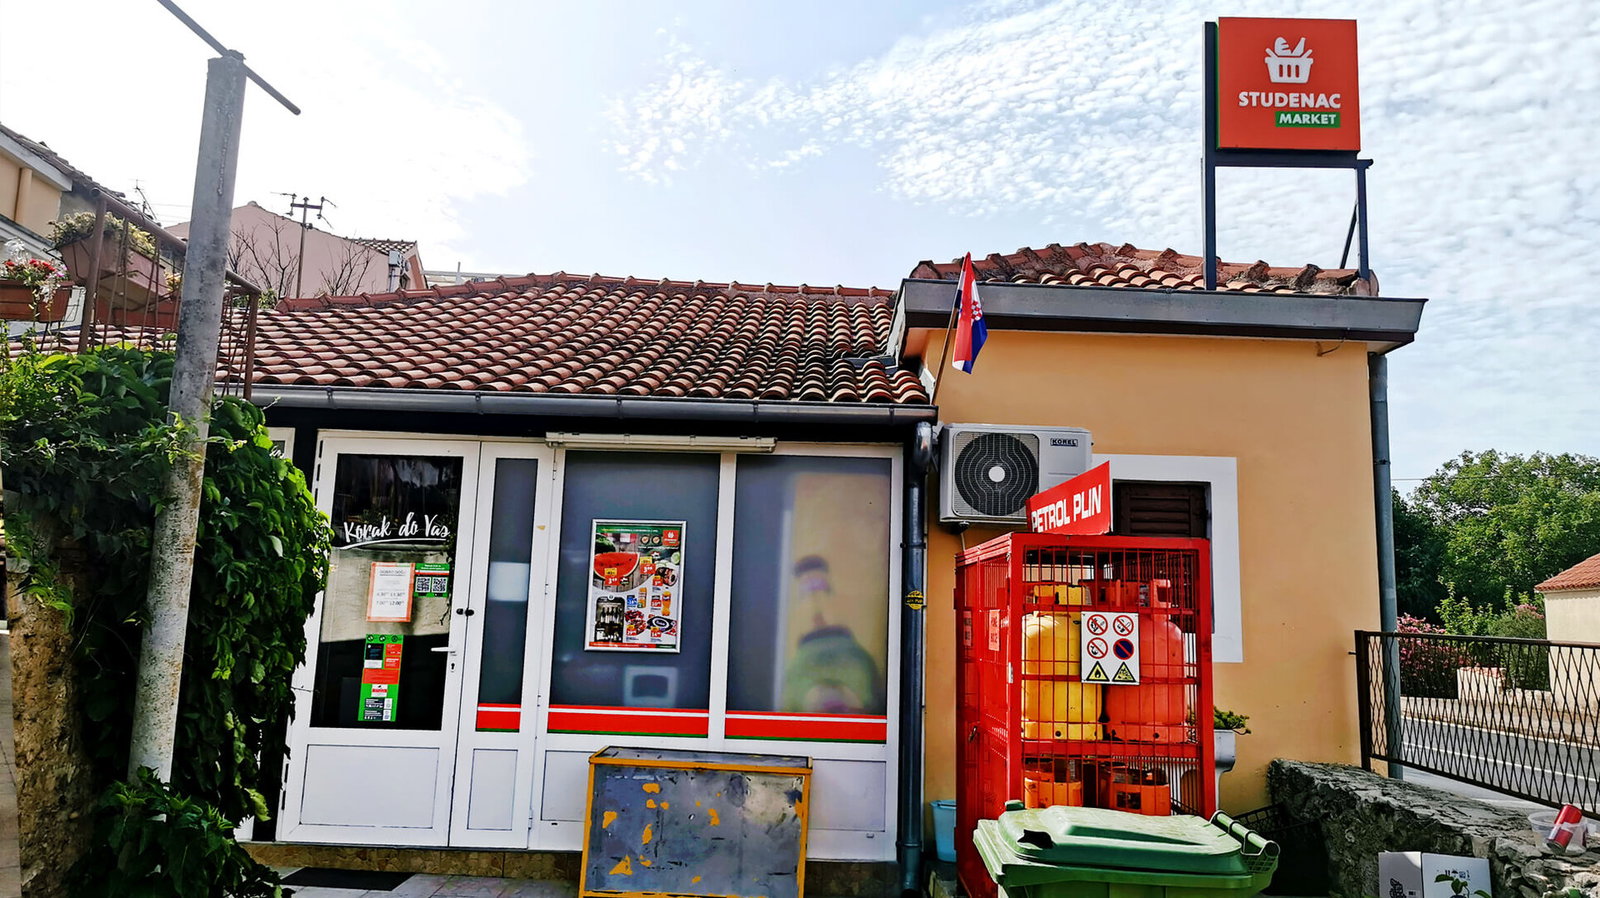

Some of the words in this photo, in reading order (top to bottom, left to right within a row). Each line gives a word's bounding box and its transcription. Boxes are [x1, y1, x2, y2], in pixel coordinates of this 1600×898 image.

[1238, 91, 1341, 109] STUDENAC
[1279, 113, 1336, 125] MARKET
[1052, 438, 1077, 446] KOREL
[1031, 498, 1071, 533] PETROL
[1073, 484, 1102, 522] PLIN
[343, 515, 392, 543] Korak
[398, 511, 418, 537] do
[424, 514, 450, 538] Vas
